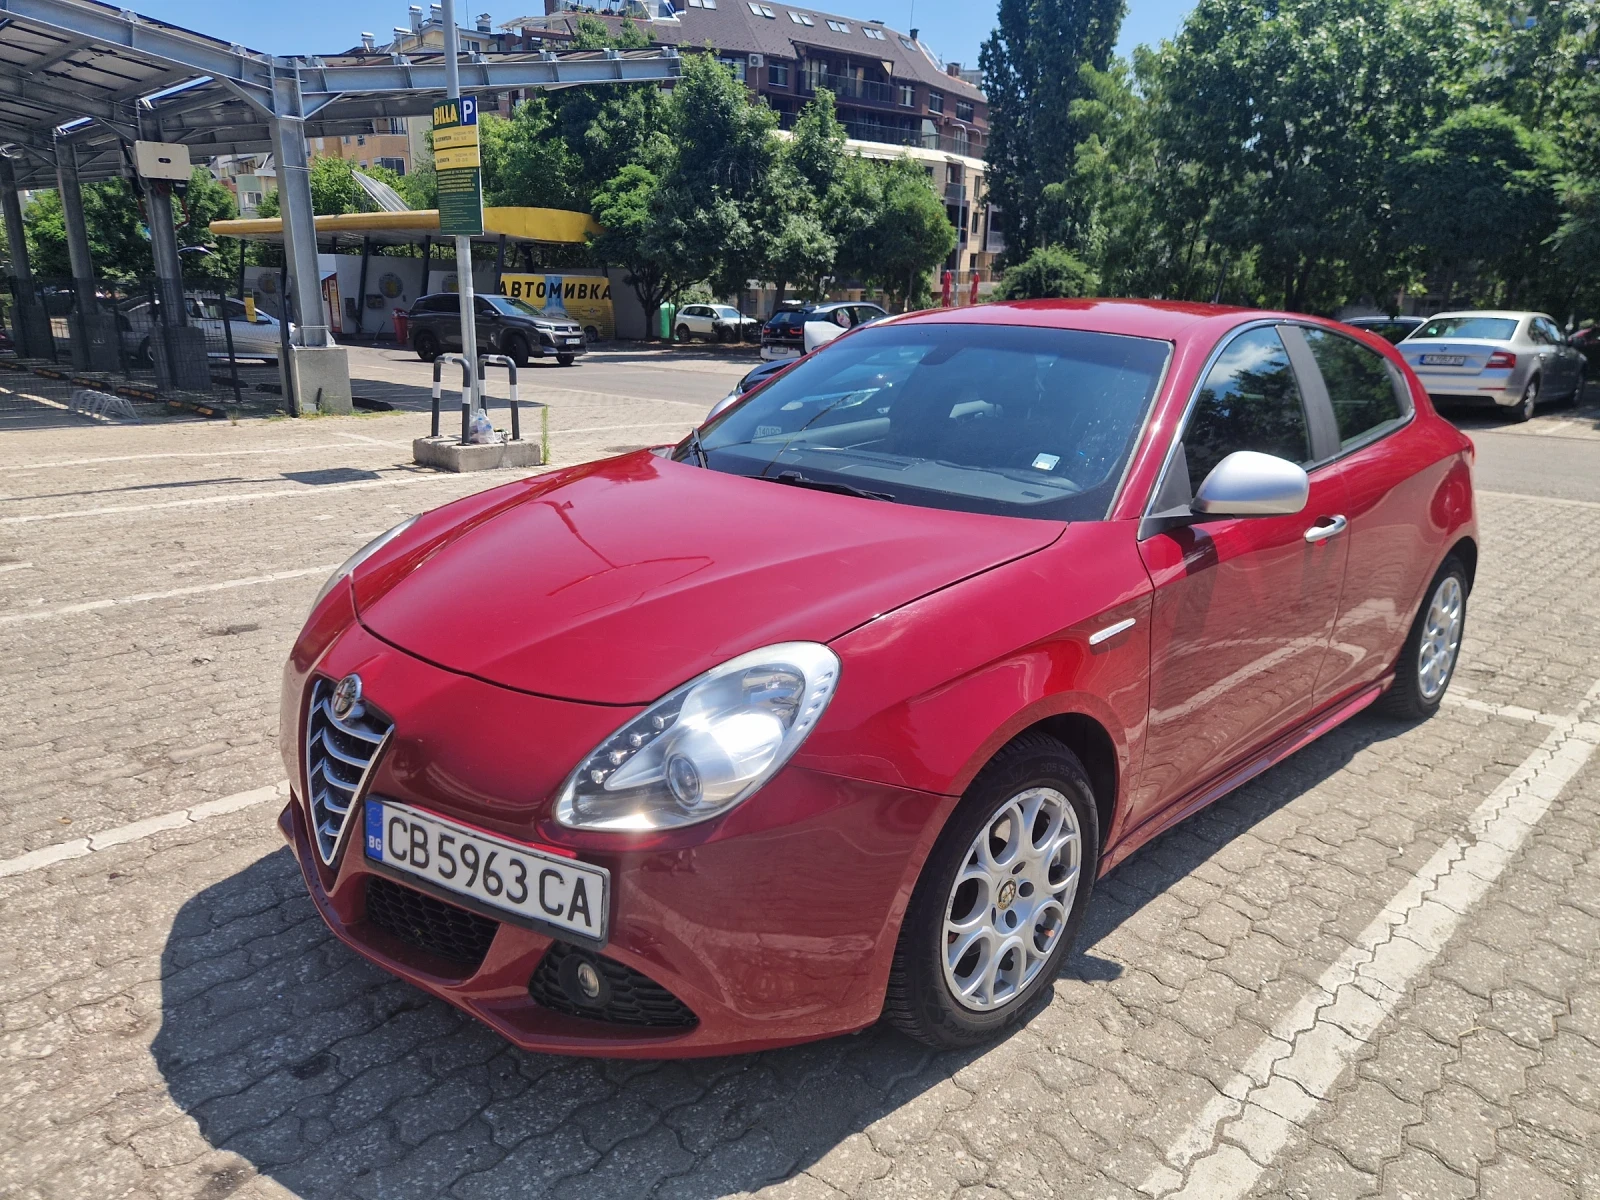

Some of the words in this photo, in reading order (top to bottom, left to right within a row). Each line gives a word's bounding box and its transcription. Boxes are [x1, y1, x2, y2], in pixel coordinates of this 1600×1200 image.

[433, 103, 458, 125] BILLA
[463, 100, 474, 123] P
[500, 281, 612, 300] АВТОМИВКА
[368, 835, 382, 851] BG
